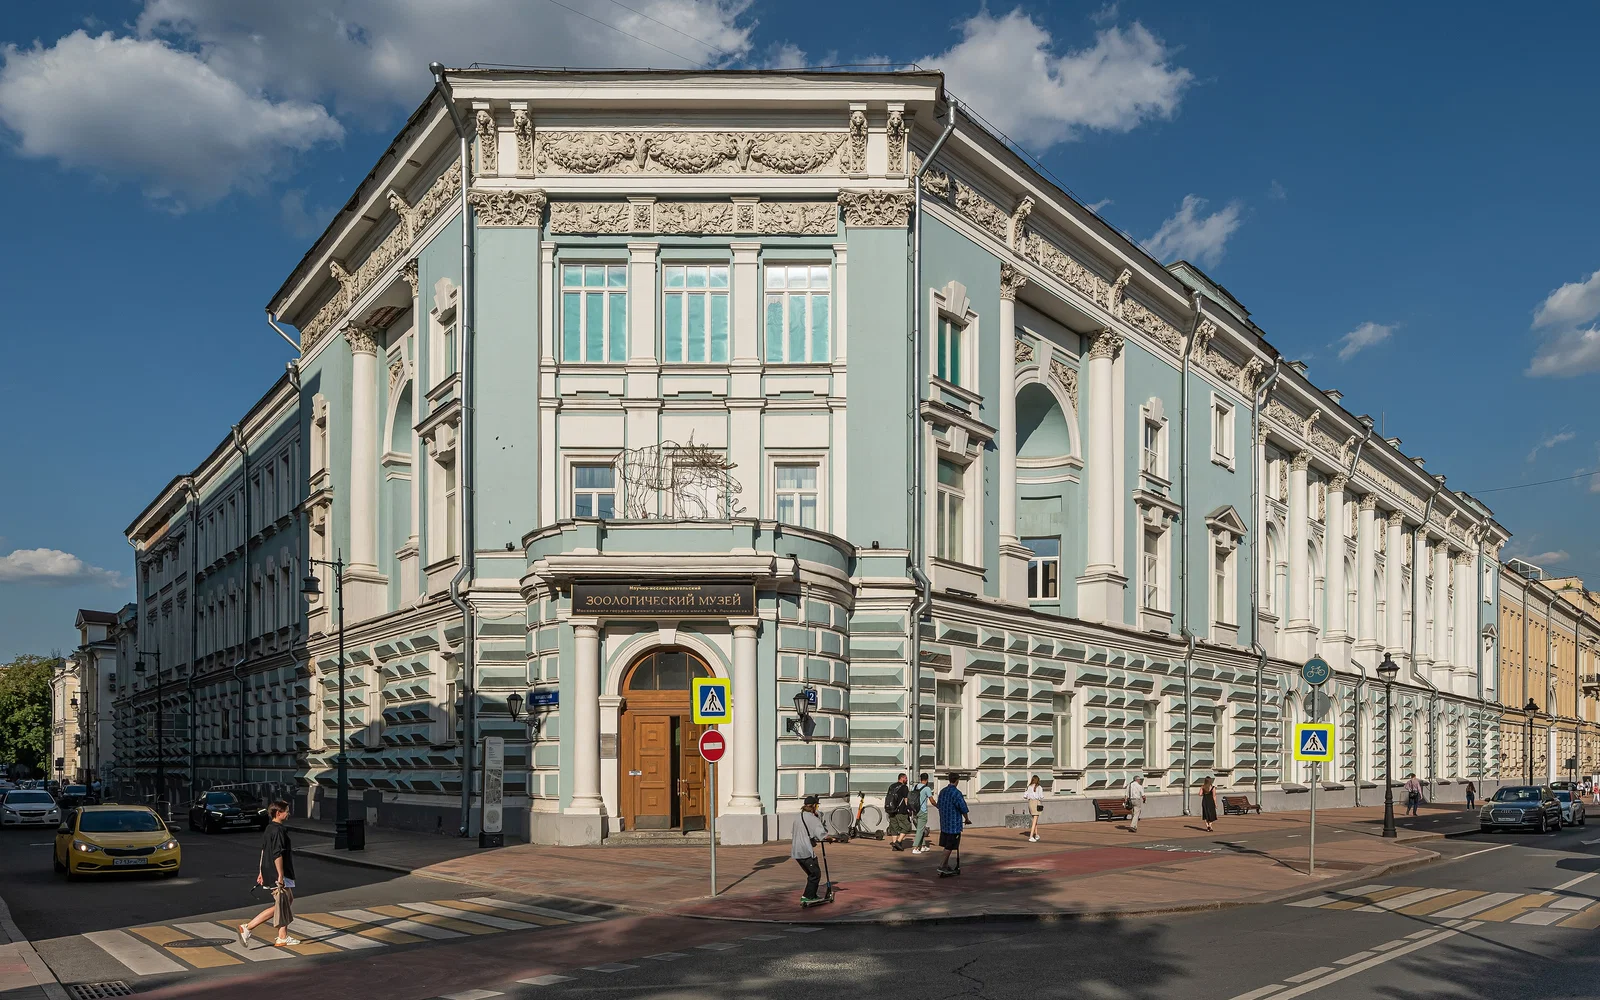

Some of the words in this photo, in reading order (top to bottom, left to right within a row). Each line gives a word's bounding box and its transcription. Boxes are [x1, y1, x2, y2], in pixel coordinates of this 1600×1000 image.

[586, 594, 695, 606] ЗООЛОГИЧЕСКИЙ
[699, 594, 741, 606] МУЗЕЙ
[809, 692, 814, 701] 2
